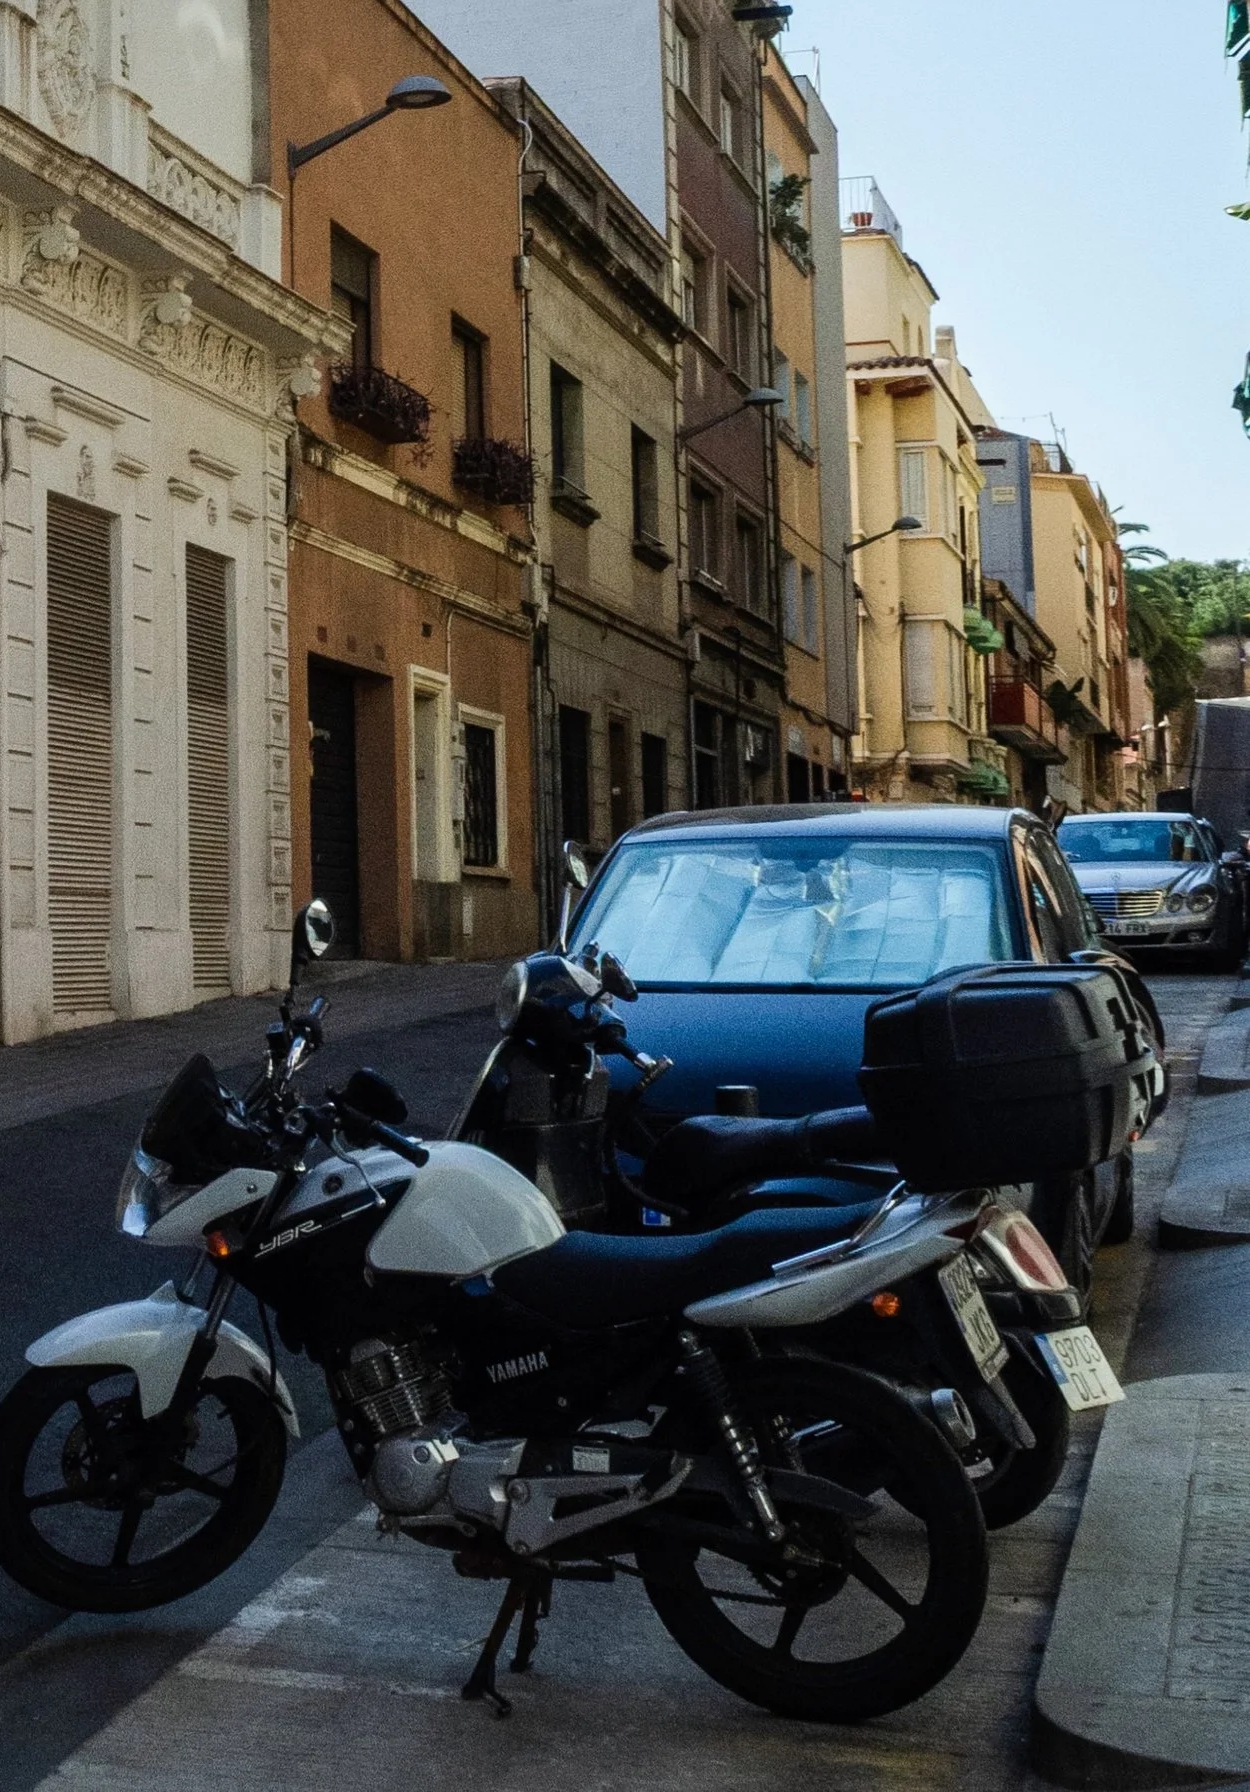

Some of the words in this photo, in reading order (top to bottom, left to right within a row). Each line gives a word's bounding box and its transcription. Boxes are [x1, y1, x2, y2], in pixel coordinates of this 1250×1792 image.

[259, 1219, 323, 1253] YBR
[486, 1351, 549, 1383] YAMAHA
[1055, 1334, 1102, 1369] 9703
[1070, 1368, 1108, 1402] DLT
